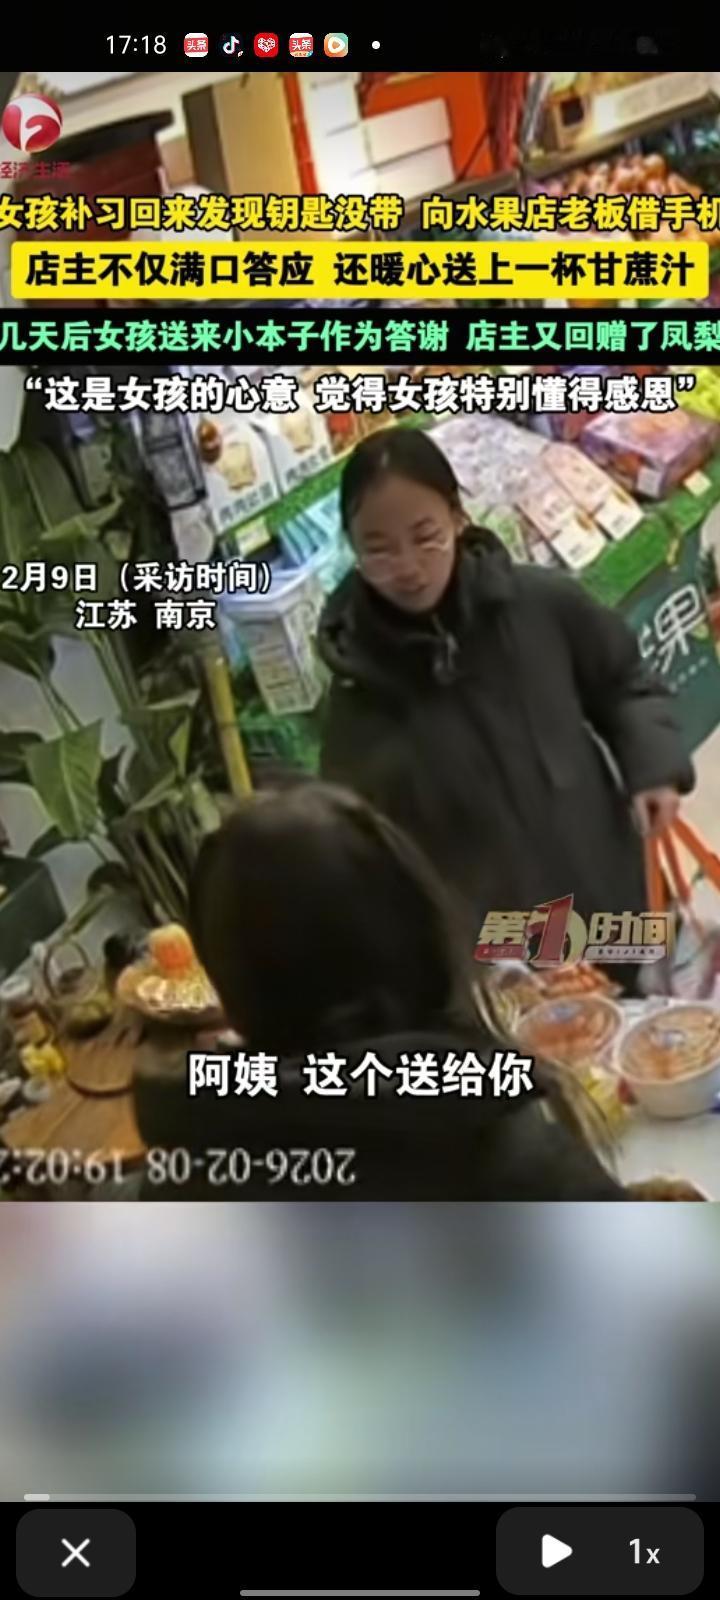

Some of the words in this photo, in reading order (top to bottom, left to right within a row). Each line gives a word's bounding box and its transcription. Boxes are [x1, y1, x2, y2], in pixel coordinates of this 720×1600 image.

[106, 35, 167, 54] 17:18
[187, 40, 207, 50] 头条
[292, 39, 311, 50] 头条
[628, 1538, 660, 1564] 1x
